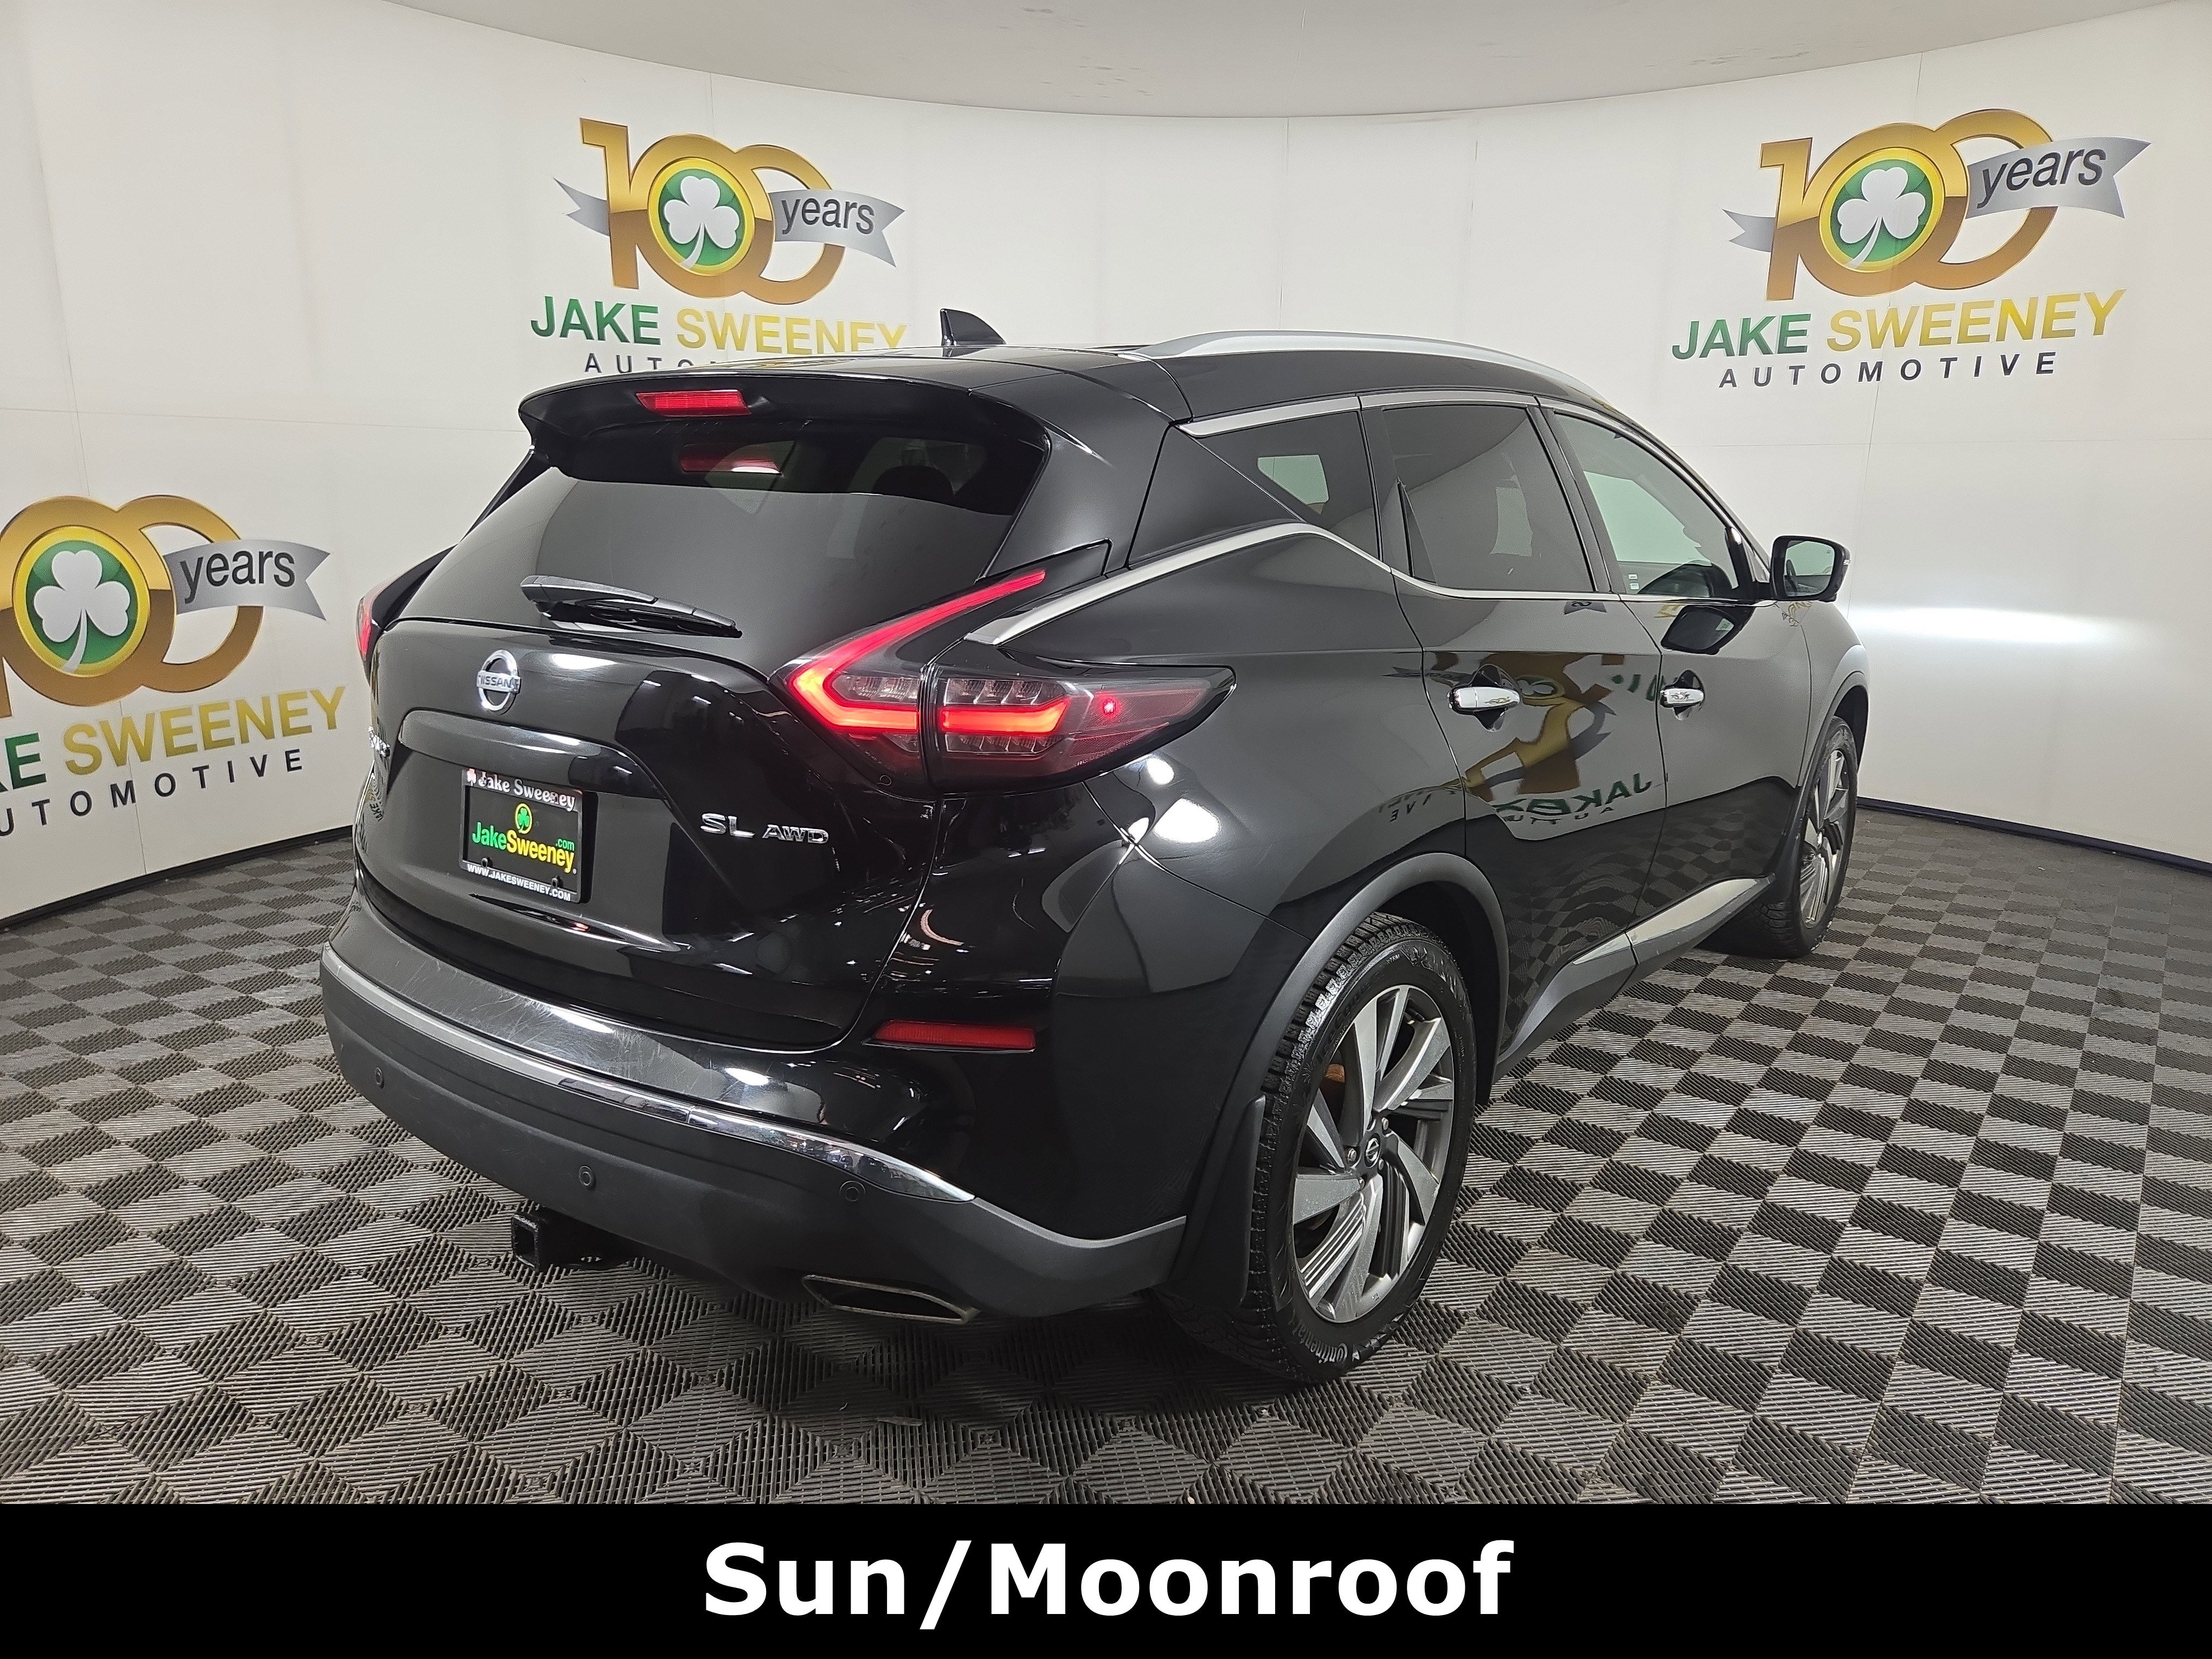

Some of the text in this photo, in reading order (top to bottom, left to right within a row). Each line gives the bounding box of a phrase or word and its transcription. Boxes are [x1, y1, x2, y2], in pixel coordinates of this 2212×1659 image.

[1977, 147, 2107, 208] years
[781, 198, 875, 235] years
[530, 296, 908, 355] JAKE SWEENEY
[1671, 289, 2127, 360] JAKE SWEENEY
[1719, 352, 2057, 389] AUTOMOTIVE
[179, 550, 296, 603] years
[478, 675, 514, 689] NISSAN
[63, 686, 346, 776] SWEENEY
[0, 749, 303, 837] UTOMOTIVE
[478, 771, 575, 812] Jake Sweeney
[556, 838, 575, 851] .com
[700, 813, 829, 844] SL AWD
[467, 863, 571, 902] WWW.JAKESWEENEY.COM
